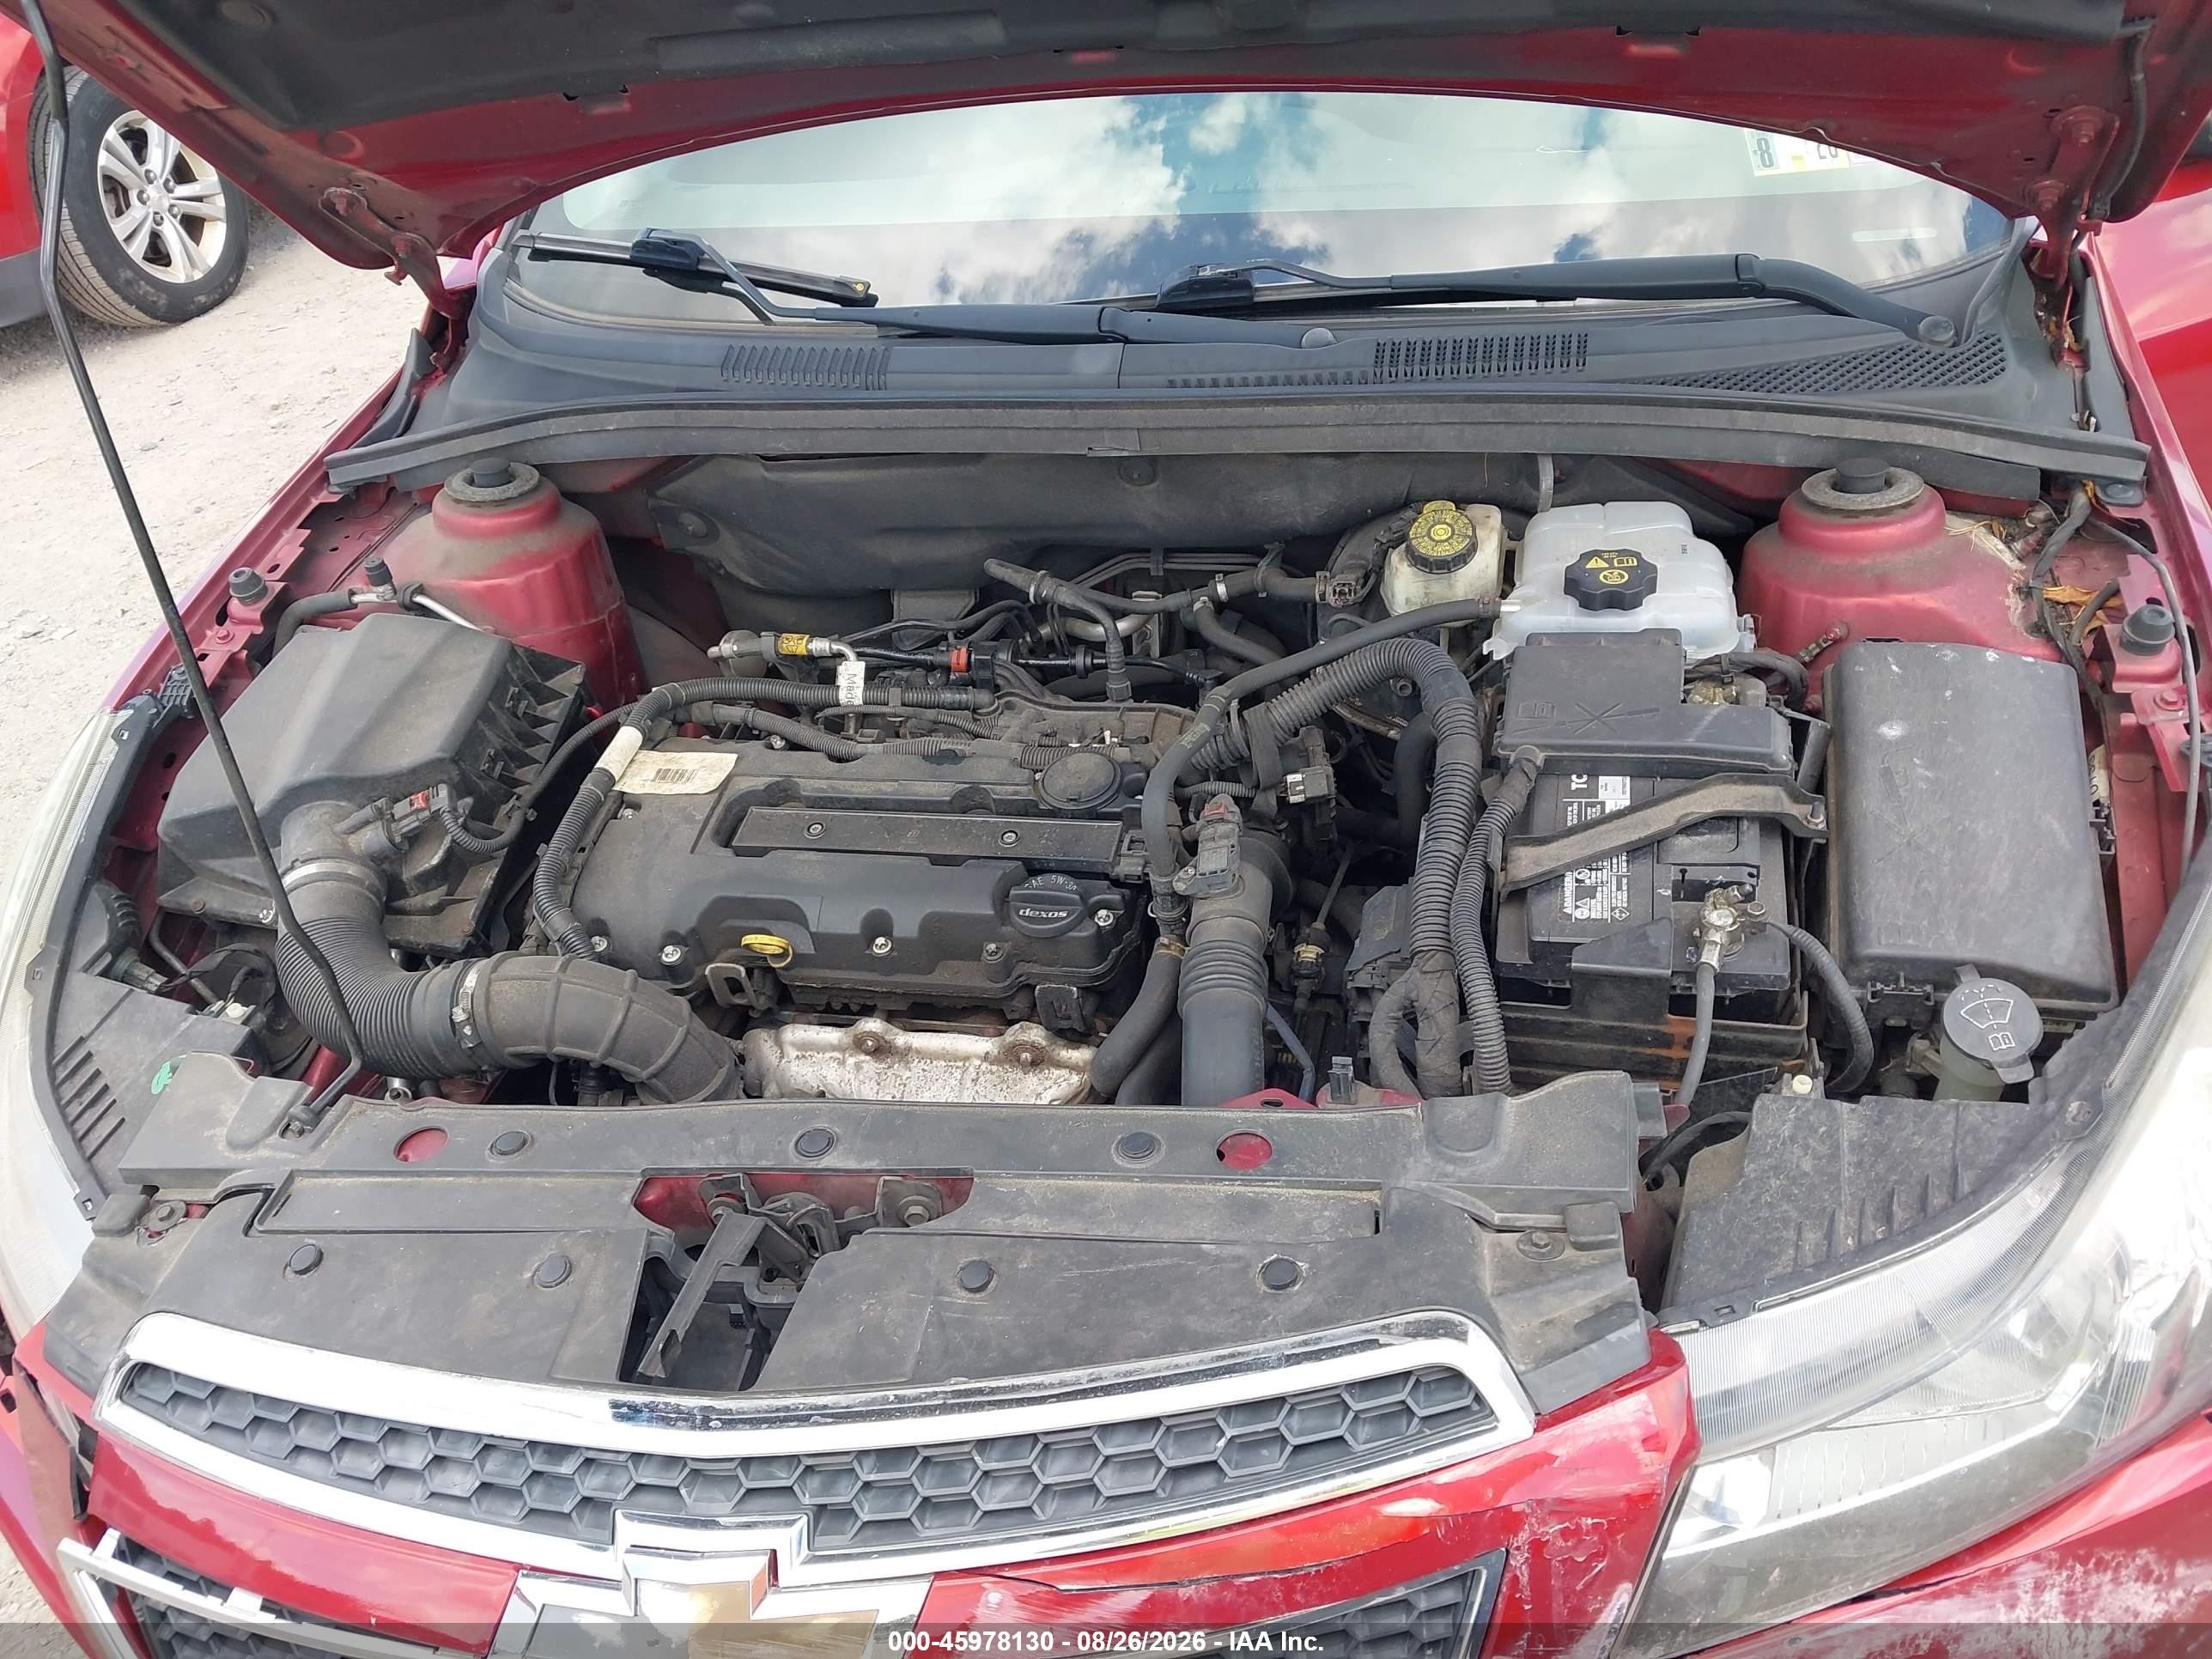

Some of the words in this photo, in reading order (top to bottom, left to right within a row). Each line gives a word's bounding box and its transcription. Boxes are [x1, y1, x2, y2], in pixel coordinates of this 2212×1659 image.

[1756, 137, 1774, 168] 8
[846, 673, 857, 706] Made
[1018, 908, 1068, 918] dexos
